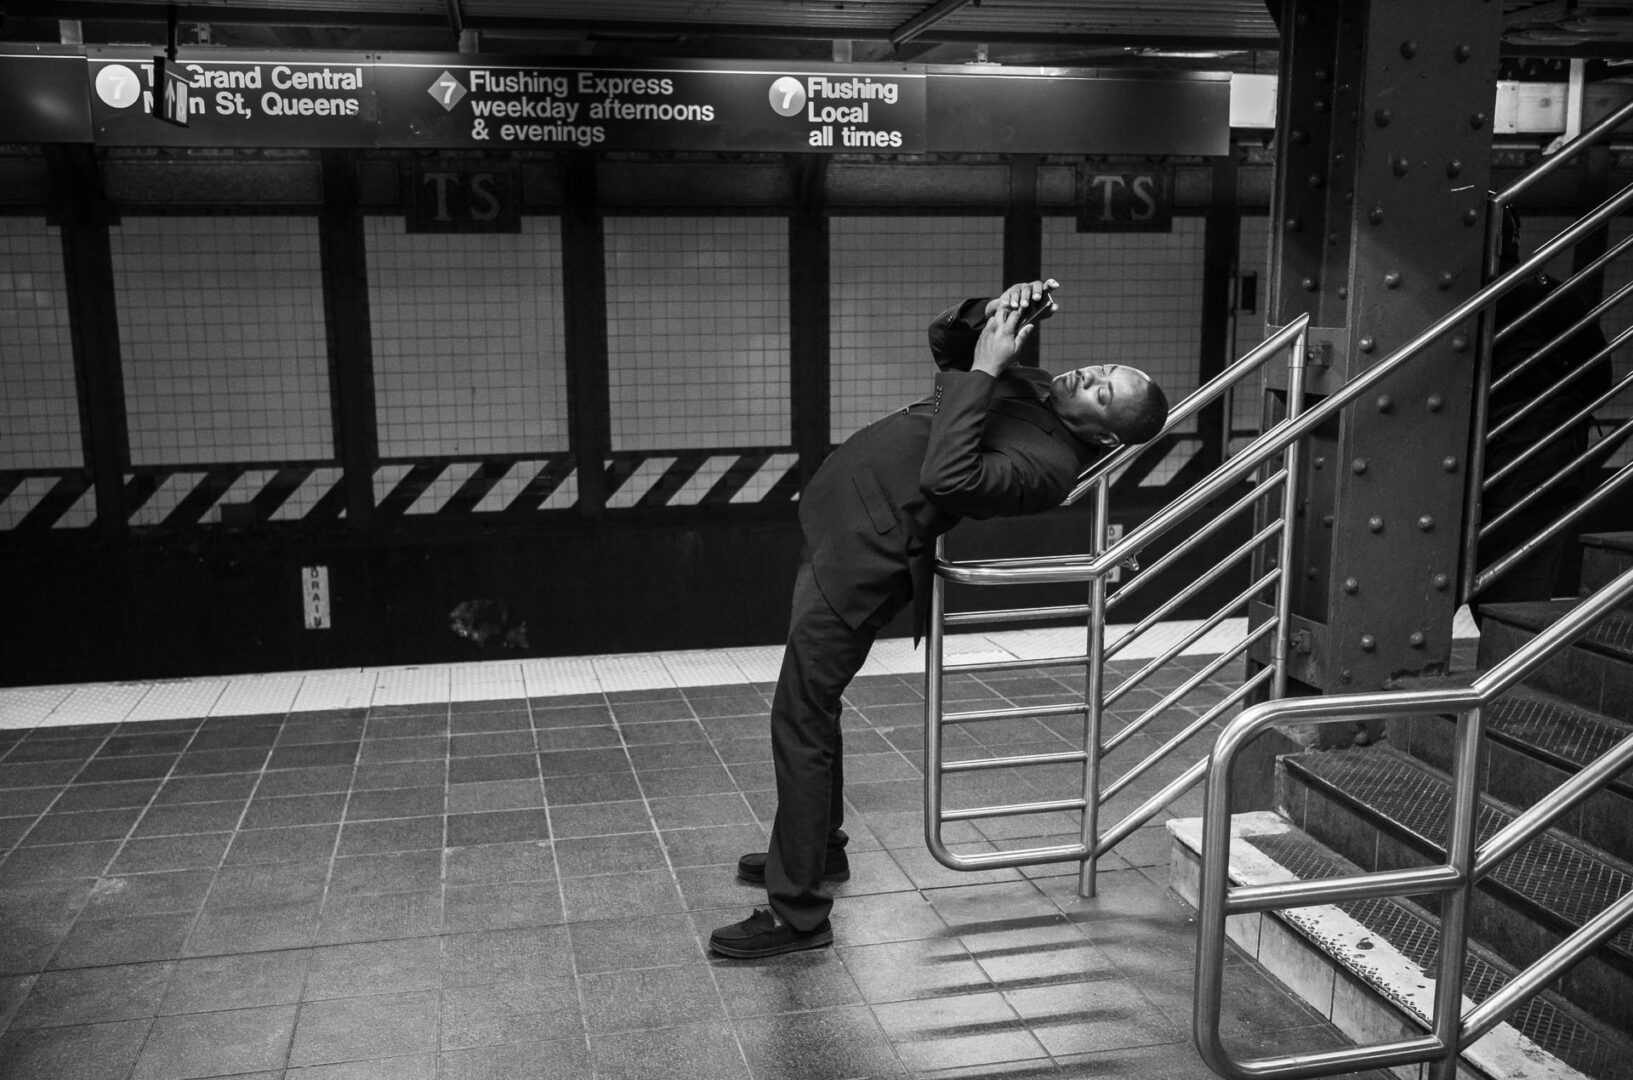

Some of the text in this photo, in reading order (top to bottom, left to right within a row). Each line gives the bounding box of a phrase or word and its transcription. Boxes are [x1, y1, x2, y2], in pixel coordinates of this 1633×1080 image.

[109, 76, 127, 99] 7
[186, 64, 262, 89] Grand
[271, 66, 363, 90] Central
[470, 70, 674, 98] Flushing Express
[808, 77, 898, 104] Flushing
[216, 91, 251, 119] St,
[261, 92, 359, 116] Queens
[440, 82, 457, 104] 7
[779, 81, 797, 109] 7
[471, 96, 715, 122] weekday afternoons
[808, 101, 868, 123] Local
[471, 118, 605, 147] & evenings
[808, 125, 902, 147] all times
[1092, 175, 1155, 221] TS
[310, 567, 322, 627] DRAIN
